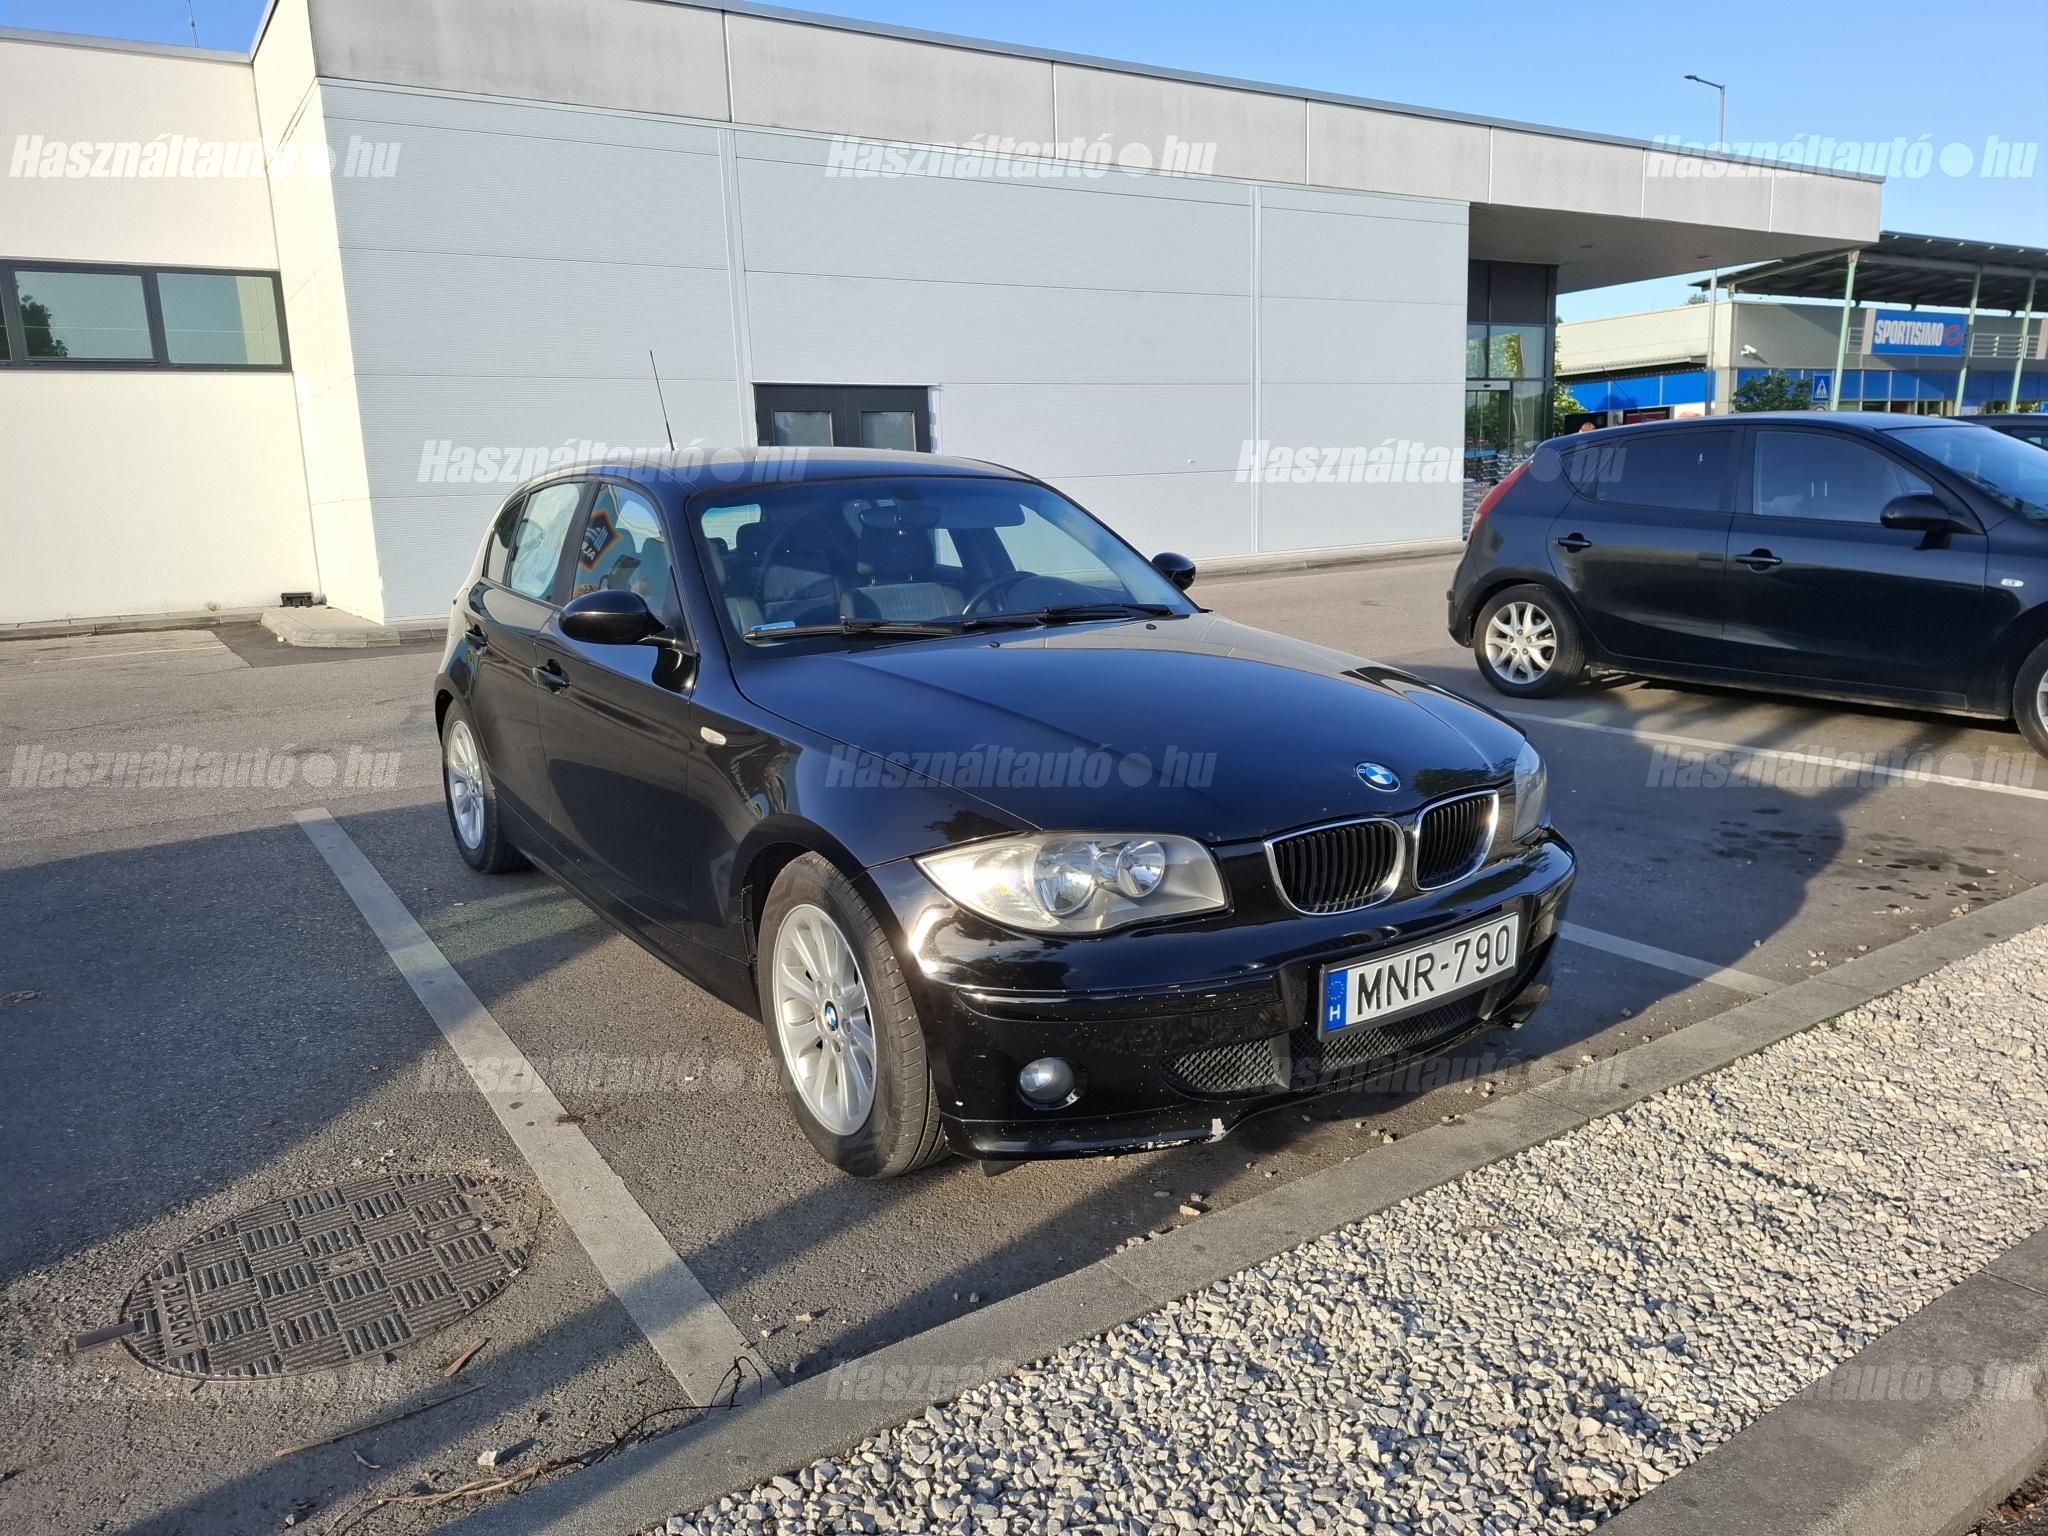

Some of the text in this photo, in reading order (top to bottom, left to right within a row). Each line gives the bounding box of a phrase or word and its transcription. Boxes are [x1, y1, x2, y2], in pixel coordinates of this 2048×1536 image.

[1874, 319, 1944, 347] SPORTISIMO
[1329, 924, 1510, 1022] H MNR-790
[160, 1281, 196, 1349] HYDROTEC
